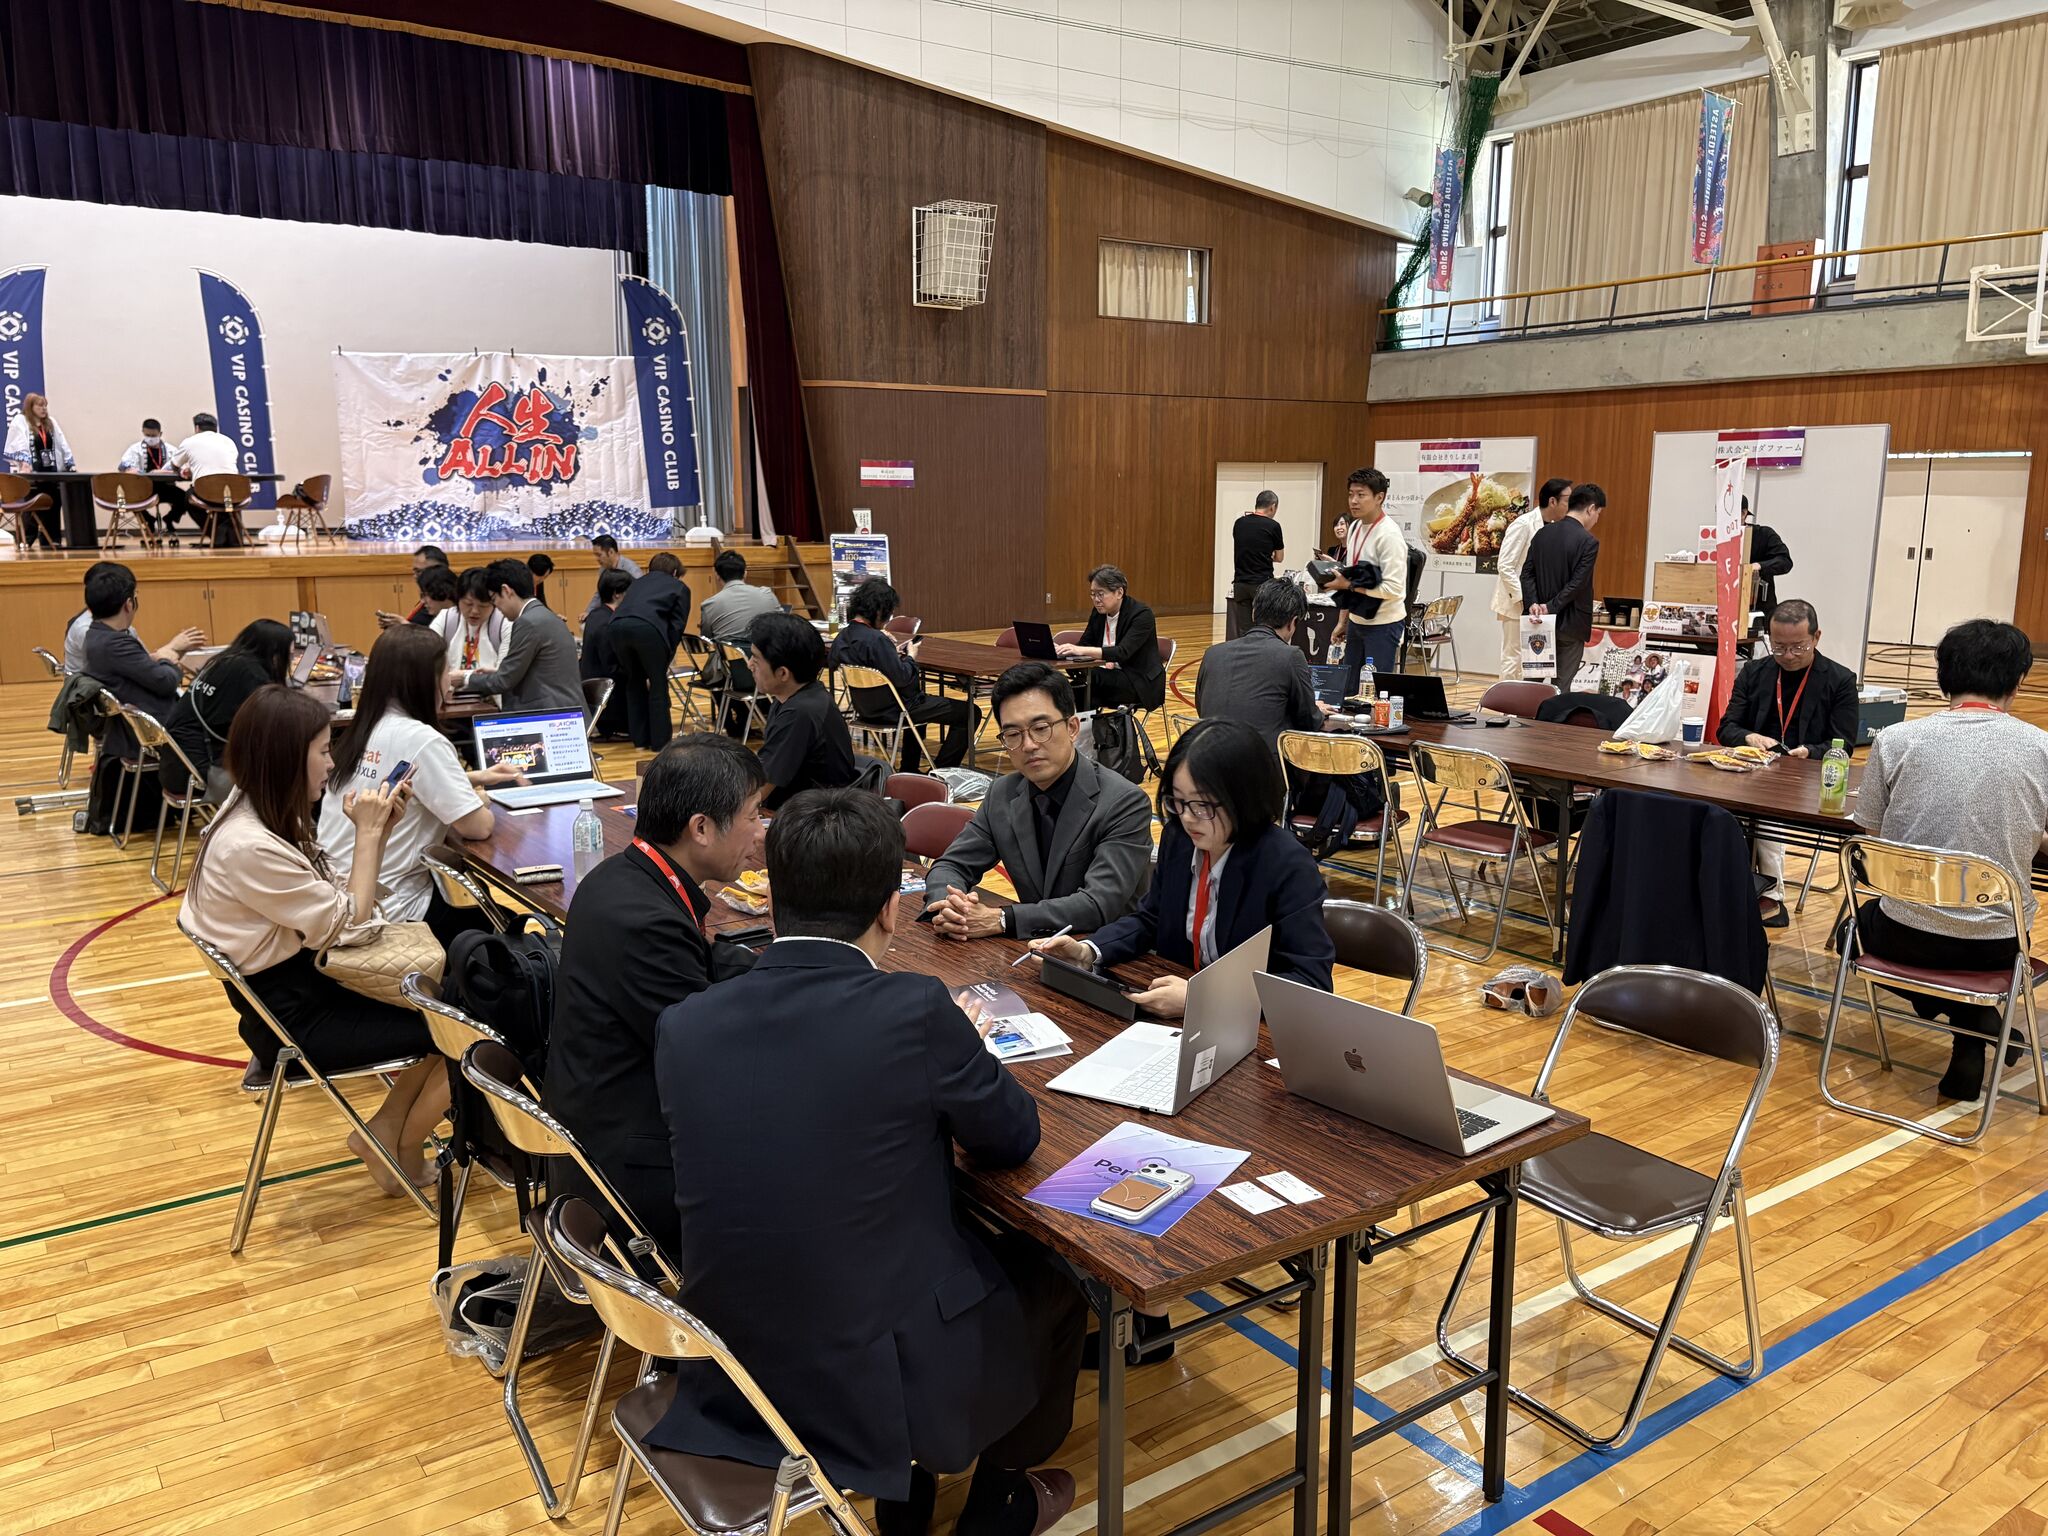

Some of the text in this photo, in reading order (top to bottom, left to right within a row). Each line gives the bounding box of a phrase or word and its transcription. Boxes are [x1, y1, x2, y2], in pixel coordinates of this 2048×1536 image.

[2, 350, 19, 380] VIP
[231, 353, 247, 381] VIP
[234, 385, 255, 448] CASINO
[460, 382, 564, 444] 人生
[653, 353, 680, 491] VIP CASINO CLUB
[360, 766, 378, 779] XL8
[1093, 1158, 1135, 1176] Per
